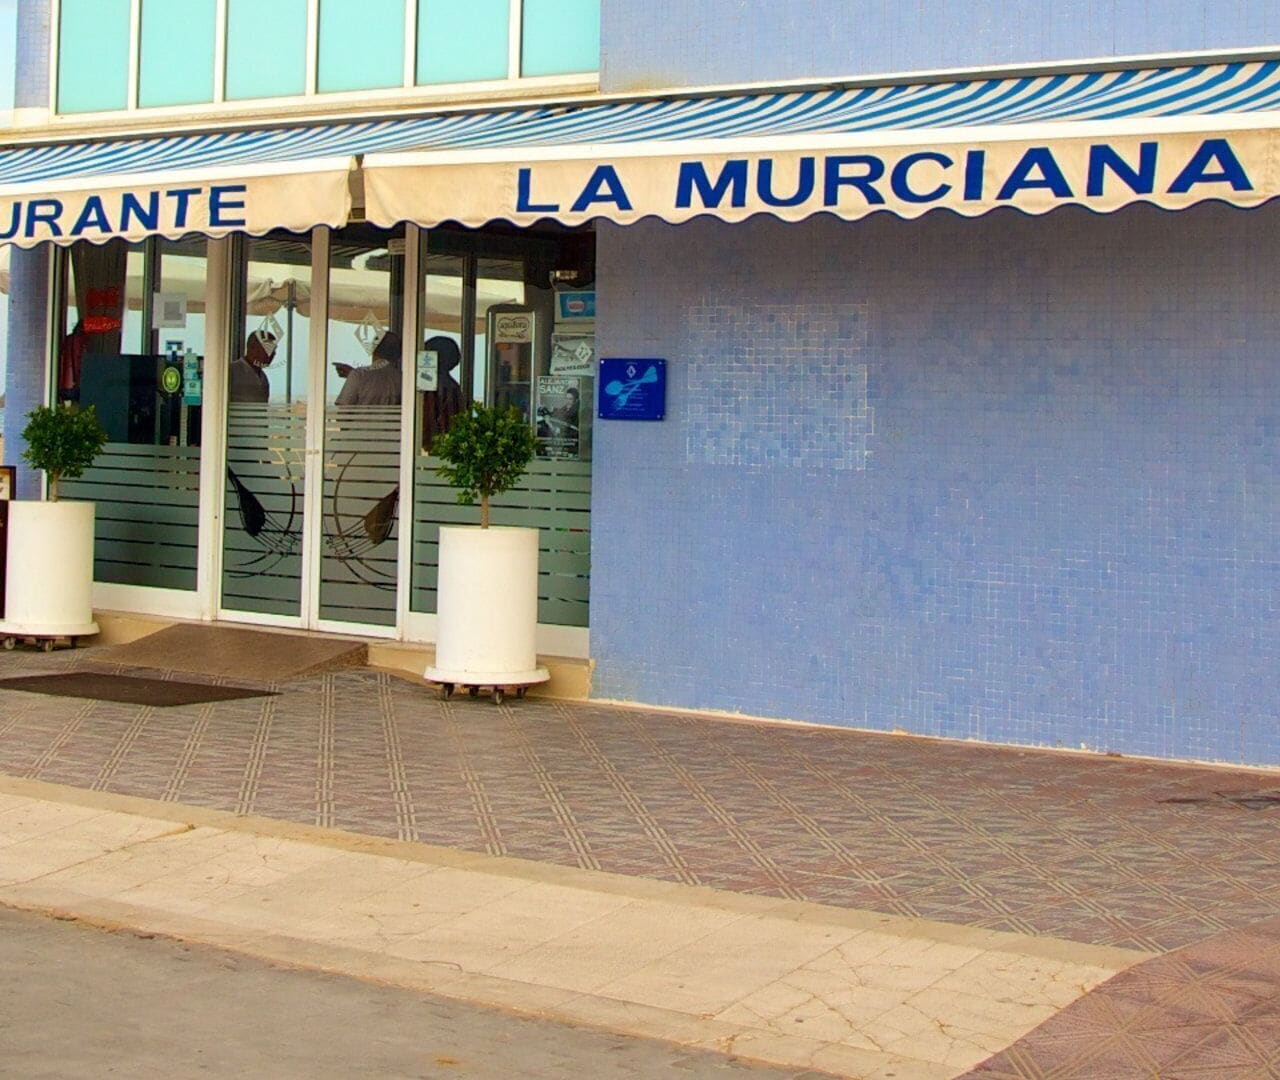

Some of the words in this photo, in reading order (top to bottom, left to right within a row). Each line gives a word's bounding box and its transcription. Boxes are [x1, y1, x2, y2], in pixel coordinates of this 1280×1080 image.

[516, 162, 634, 213] LA
[675, 138, 1254, 209] MURCIANA
[539, 385, 565, 394] SANZ
